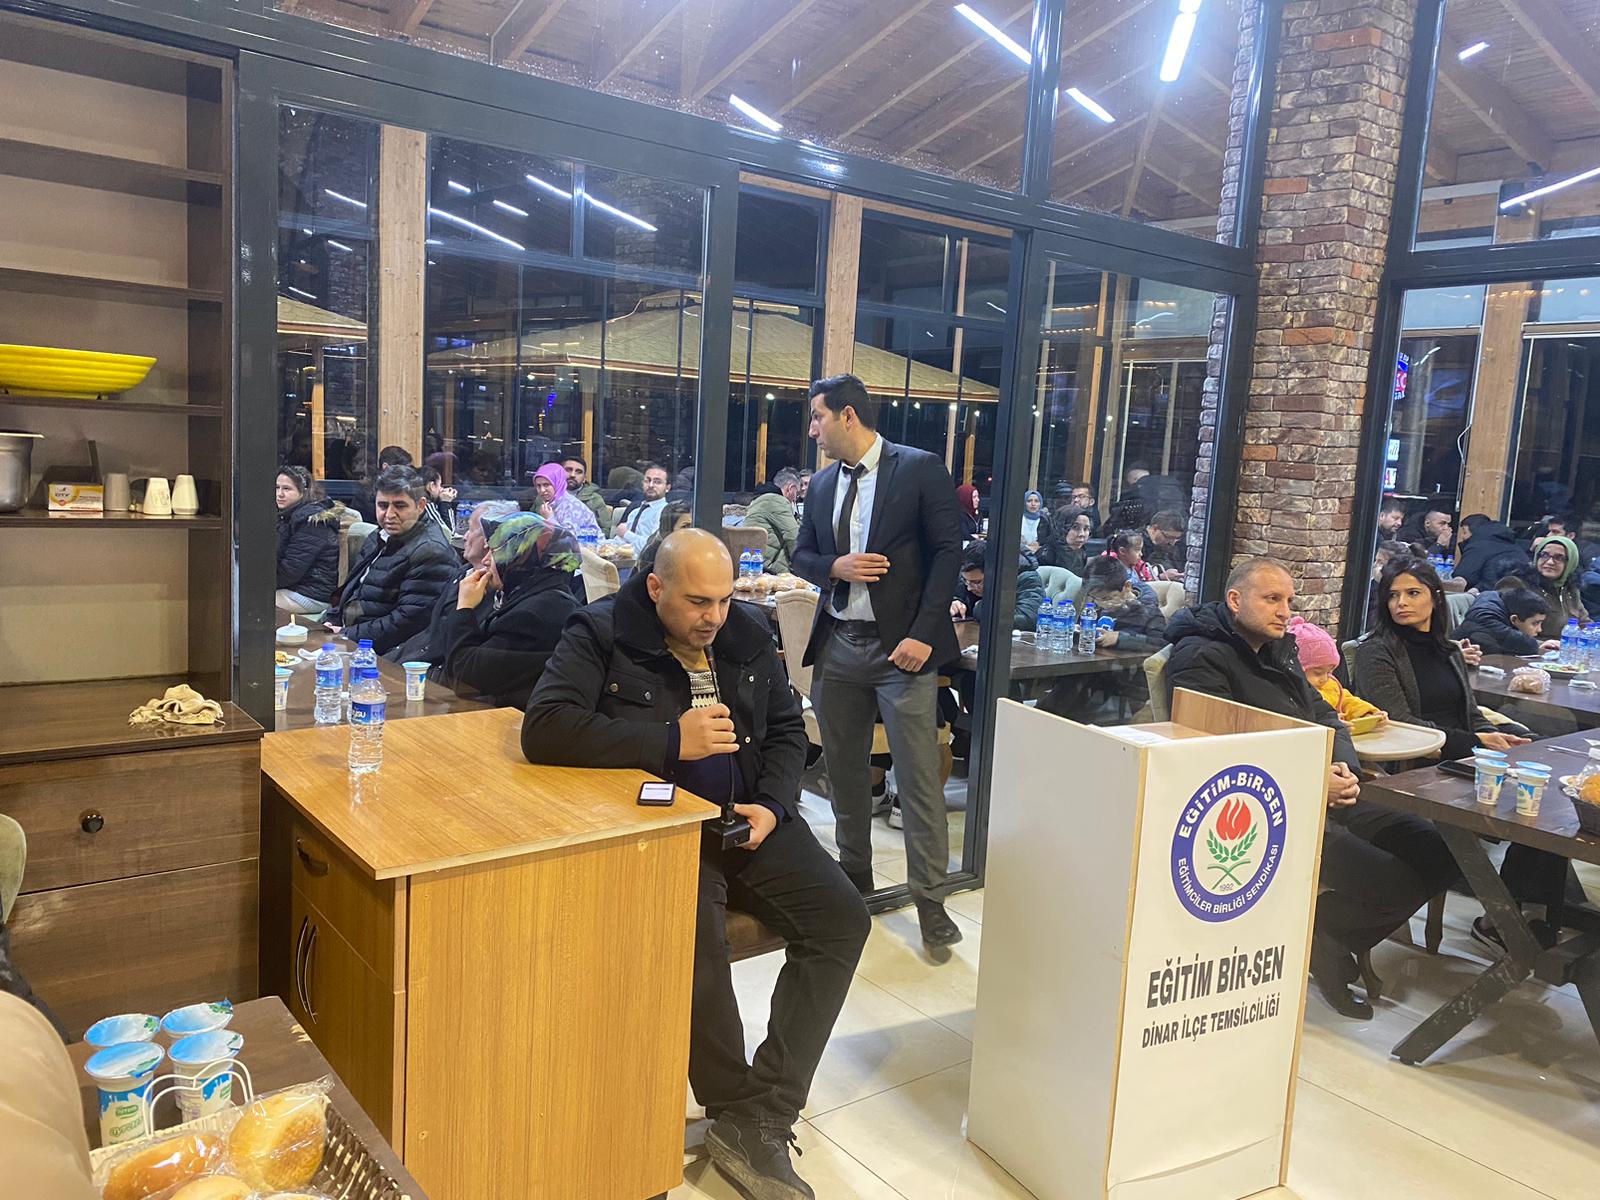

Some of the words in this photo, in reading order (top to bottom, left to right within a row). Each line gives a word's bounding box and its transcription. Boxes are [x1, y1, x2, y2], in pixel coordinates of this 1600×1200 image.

[1178, 857, 1212, 913] EĞİTİMCİLER
[1212, 895, 1246, 914] BİRLİĞİ
[1246, 844, 1279, 901] SENDİKASI
[1146, 953, 1214, 1009] EĞİTİM
[1216, 945, 1286, 994] BİR-SEN
[1142, 1021, 1180, 1048] DİNAR
[1181, 1014, 1208, 1042] İLÇE
[1210, 992, 1281, 1032] TEMSİLCİLİĞİ
